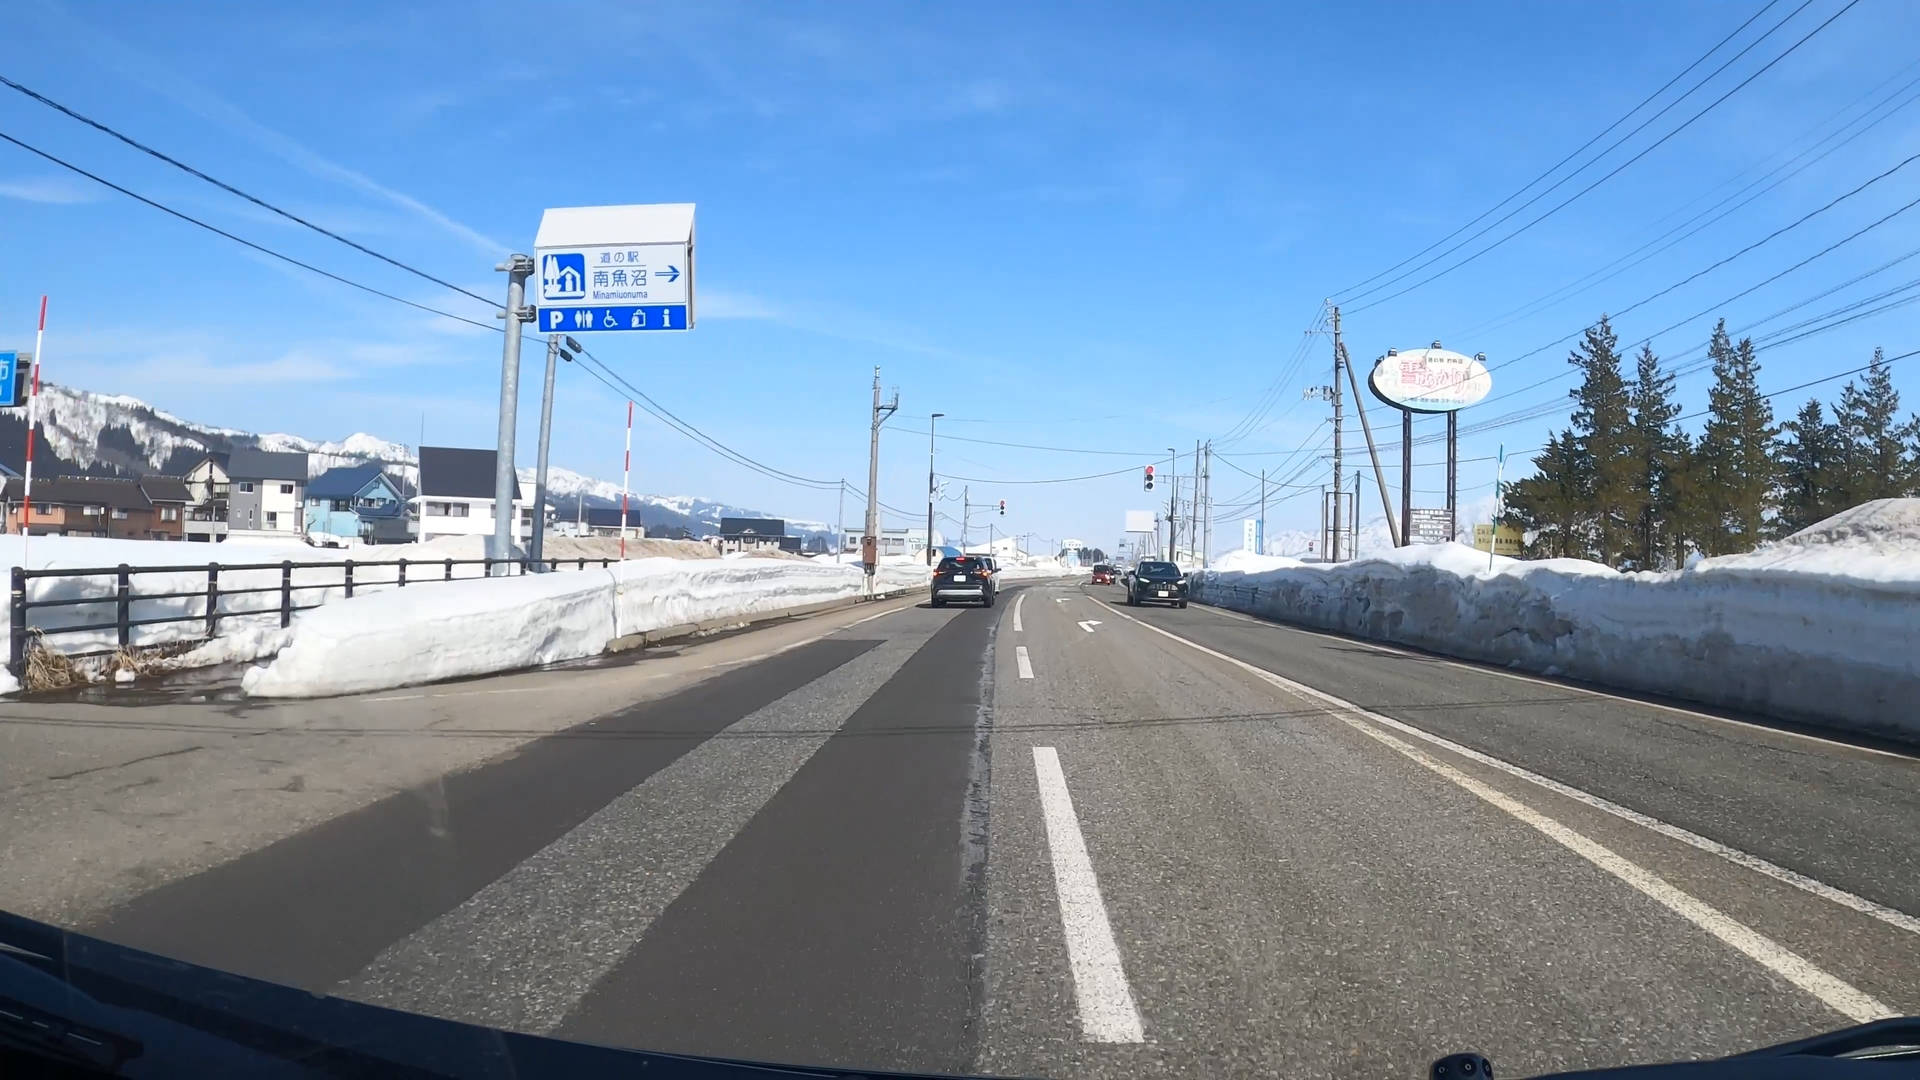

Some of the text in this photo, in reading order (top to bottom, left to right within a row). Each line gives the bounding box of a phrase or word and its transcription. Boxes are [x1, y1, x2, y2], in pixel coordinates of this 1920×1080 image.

[600, 251, 640, 263] 道の駅
[593, 269, 647, 287] 南魚沼
[593, 290, 648, 299] Minamiuonuma
